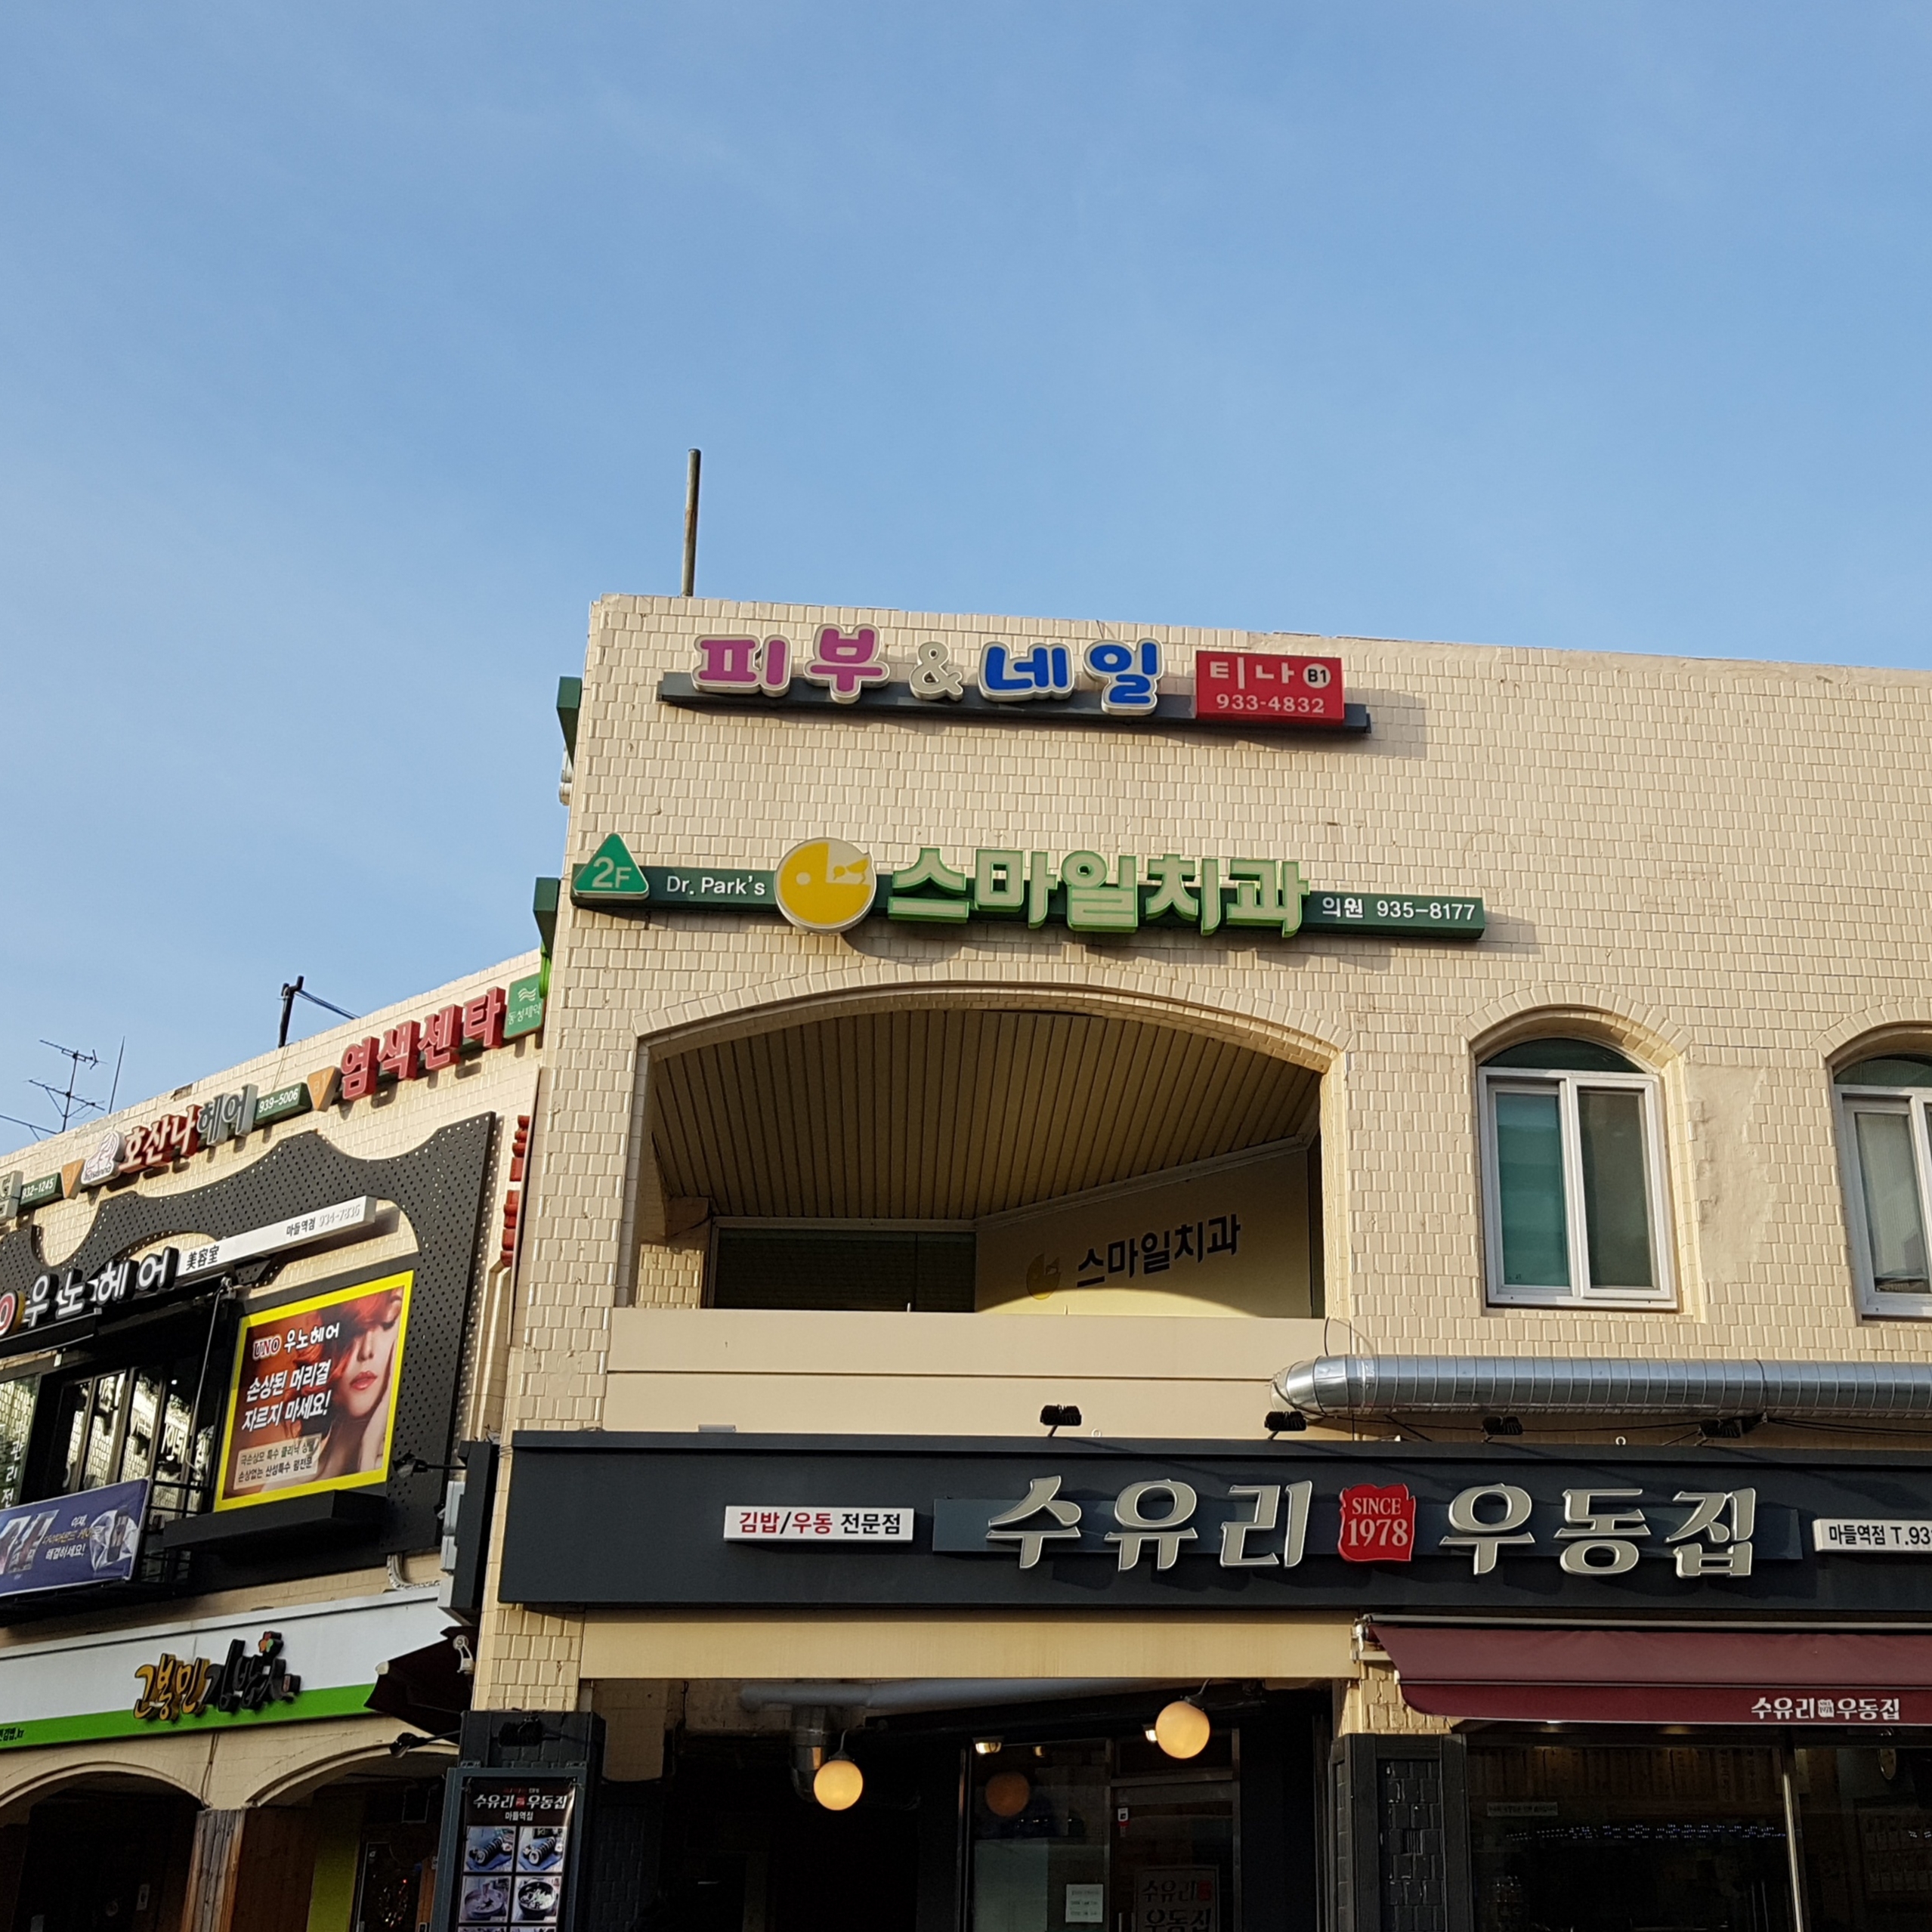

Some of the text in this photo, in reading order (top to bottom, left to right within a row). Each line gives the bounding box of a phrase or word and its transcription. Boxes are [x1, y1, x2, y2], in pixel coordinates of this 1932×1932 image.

[691, 623, 1164, 716] 피부 & 네일
[1209, 657, 1327, 689] 티나 B1
[1216, 694, 1325, 713] 933-4832
[592, 855, 632, 889] 2F
[666, 875, 765, 895] Dr. Park's
[888, 847, 1476, 937] 스마일치과 의원 935-8177
[508, 1003, 542, 1025] 동성제약
[258, 1090, 299, 1114] 939-5006
[341, 987, 505, 1100] 염색센타
[22, 1177, 54, 1200] 932-1245
[186, 1245, 219, 1271] 美容室
[286, 1217, 316, 1237] 마들역점
[1077, 1214, 1241, 1287] 스마일치과
[253, 1323, 339, 1359] UNO 우노헤어
[246, 1360, 331, 1402] 손상된 머리결
[242, 1390, 332, 1432] 자르지 마세요!
[1352, 1498, 1402, 1515] SINCE
[738, 1511, 901, 1535] 김밥/우동 전문점
[986, 1476, 1757, 1578] 수유리 우동집
[1348, 1518, 1408, 1547] 1978
[1828, 1524, 1932, 1545] 마들역점 T.93
[1751, 1697, 1900, 1720] 수유리 우동집
[473, 1794, 515, 1809] 수유리
[527, 1794, 567, 1810] 우동집
